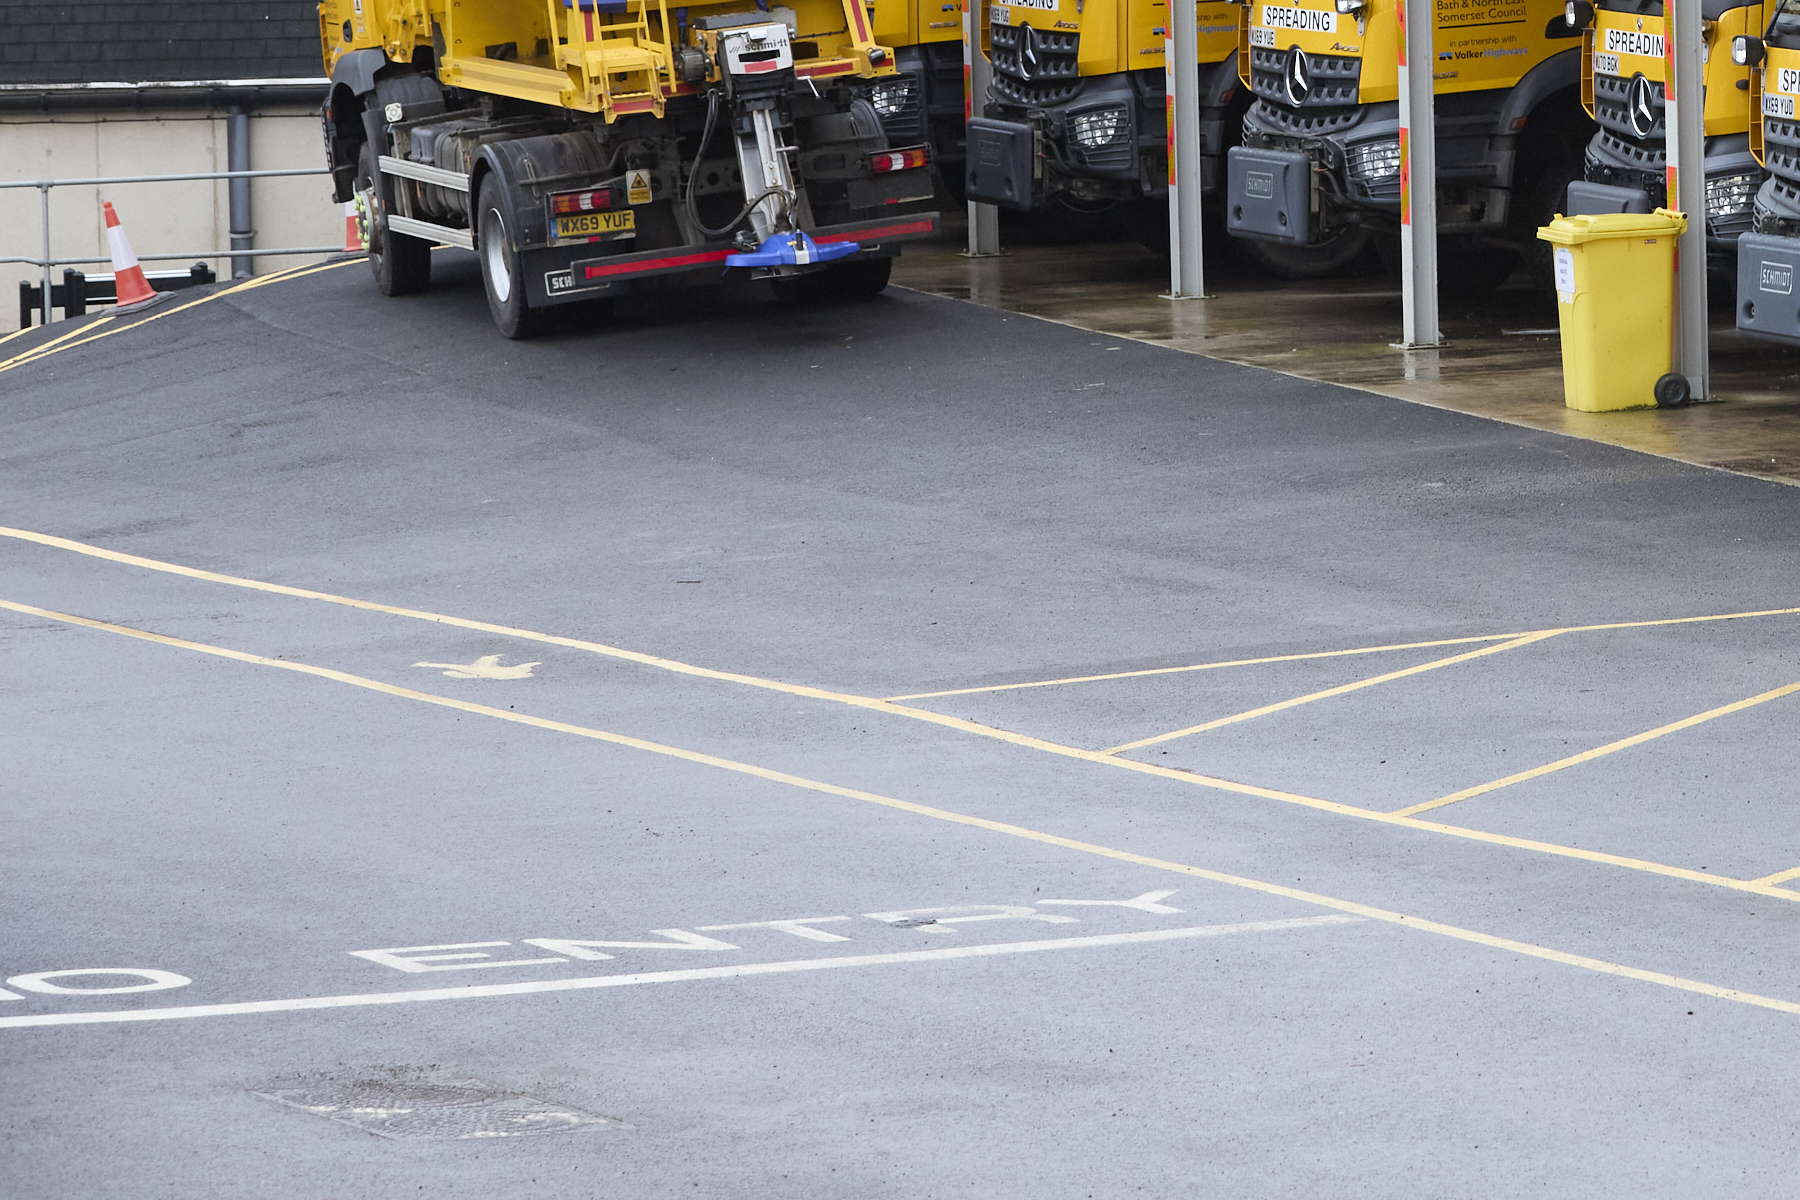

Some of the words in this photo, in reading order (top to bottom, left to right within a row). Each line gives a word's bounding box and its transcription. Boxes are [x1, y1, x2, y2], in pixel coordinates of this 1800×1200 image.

[1437, 0, 1459, 10] Bath
[1437, 12, 1485, 22] Somerset
[1488, 6, 1527, 19] Council
[1266, 6, 1330, 31] SPREADING
[745, 38, 788, 52] schmidt
[1458, 37, 1500, 48] partnership
[1501, 35, 1517, 43] with
[1608, 30, 1664, 57] SPREADIN
[561, 216, 599, 234] WX69
[603, 212, 631, 228] YUF
[1762, 268, 1791, 287] SCHMIDT
[0, 967, 192, 999] O
[348, 889, 1187, 973] ENTRY
